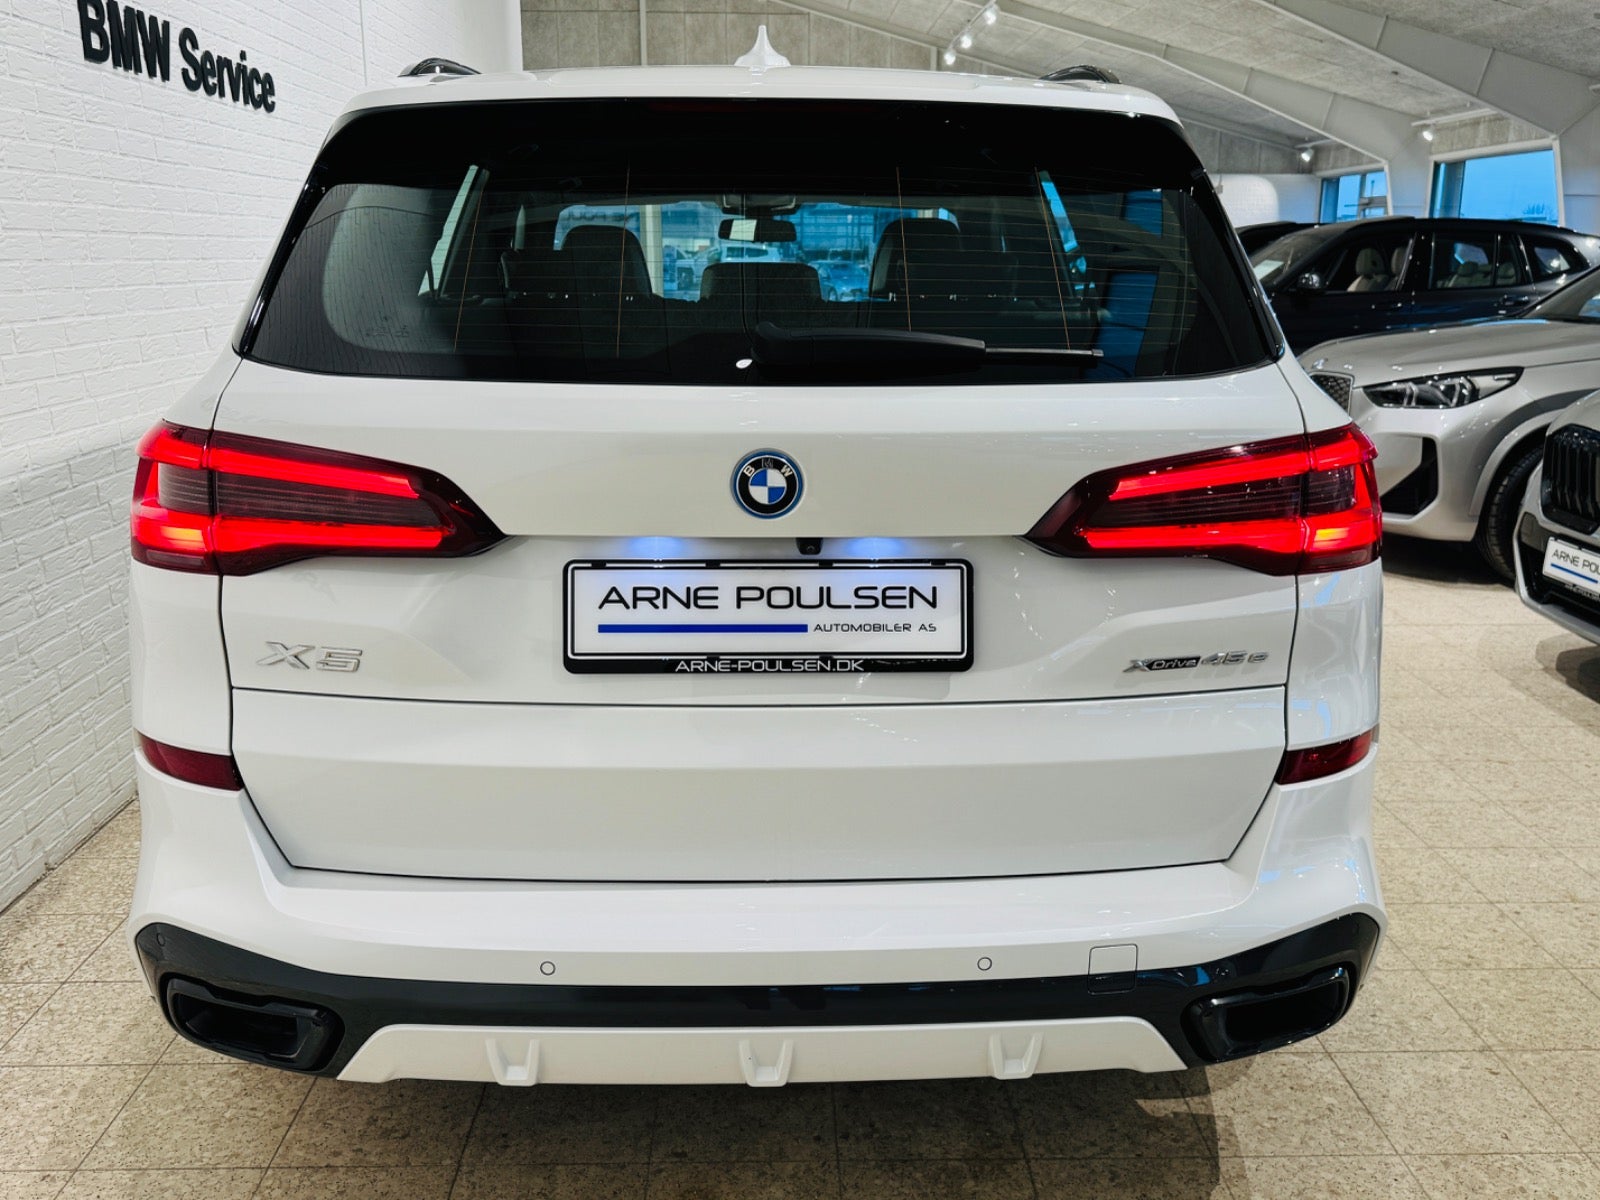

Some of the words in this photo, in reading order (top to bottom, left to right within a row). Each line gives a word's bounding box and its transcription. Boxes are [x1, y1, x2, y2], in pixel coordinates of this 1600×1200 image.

[78, 0, 170, 82] BMW
[179, 27, 275, 113] Service
[743, 457, 793, 477] BMW
[1551, 549, 1580, 567] ARNE
[598, 586, 719, 610] ARNE
[736, 586, 937, 610] POULSEN
[813, 623, 912, 633] AUTOMOBILER
[918, 623, 937, 633] AS
[256, 641, 363, 673] X5
[675, 660, 865, 672] ARNE-POULSEN.DK
